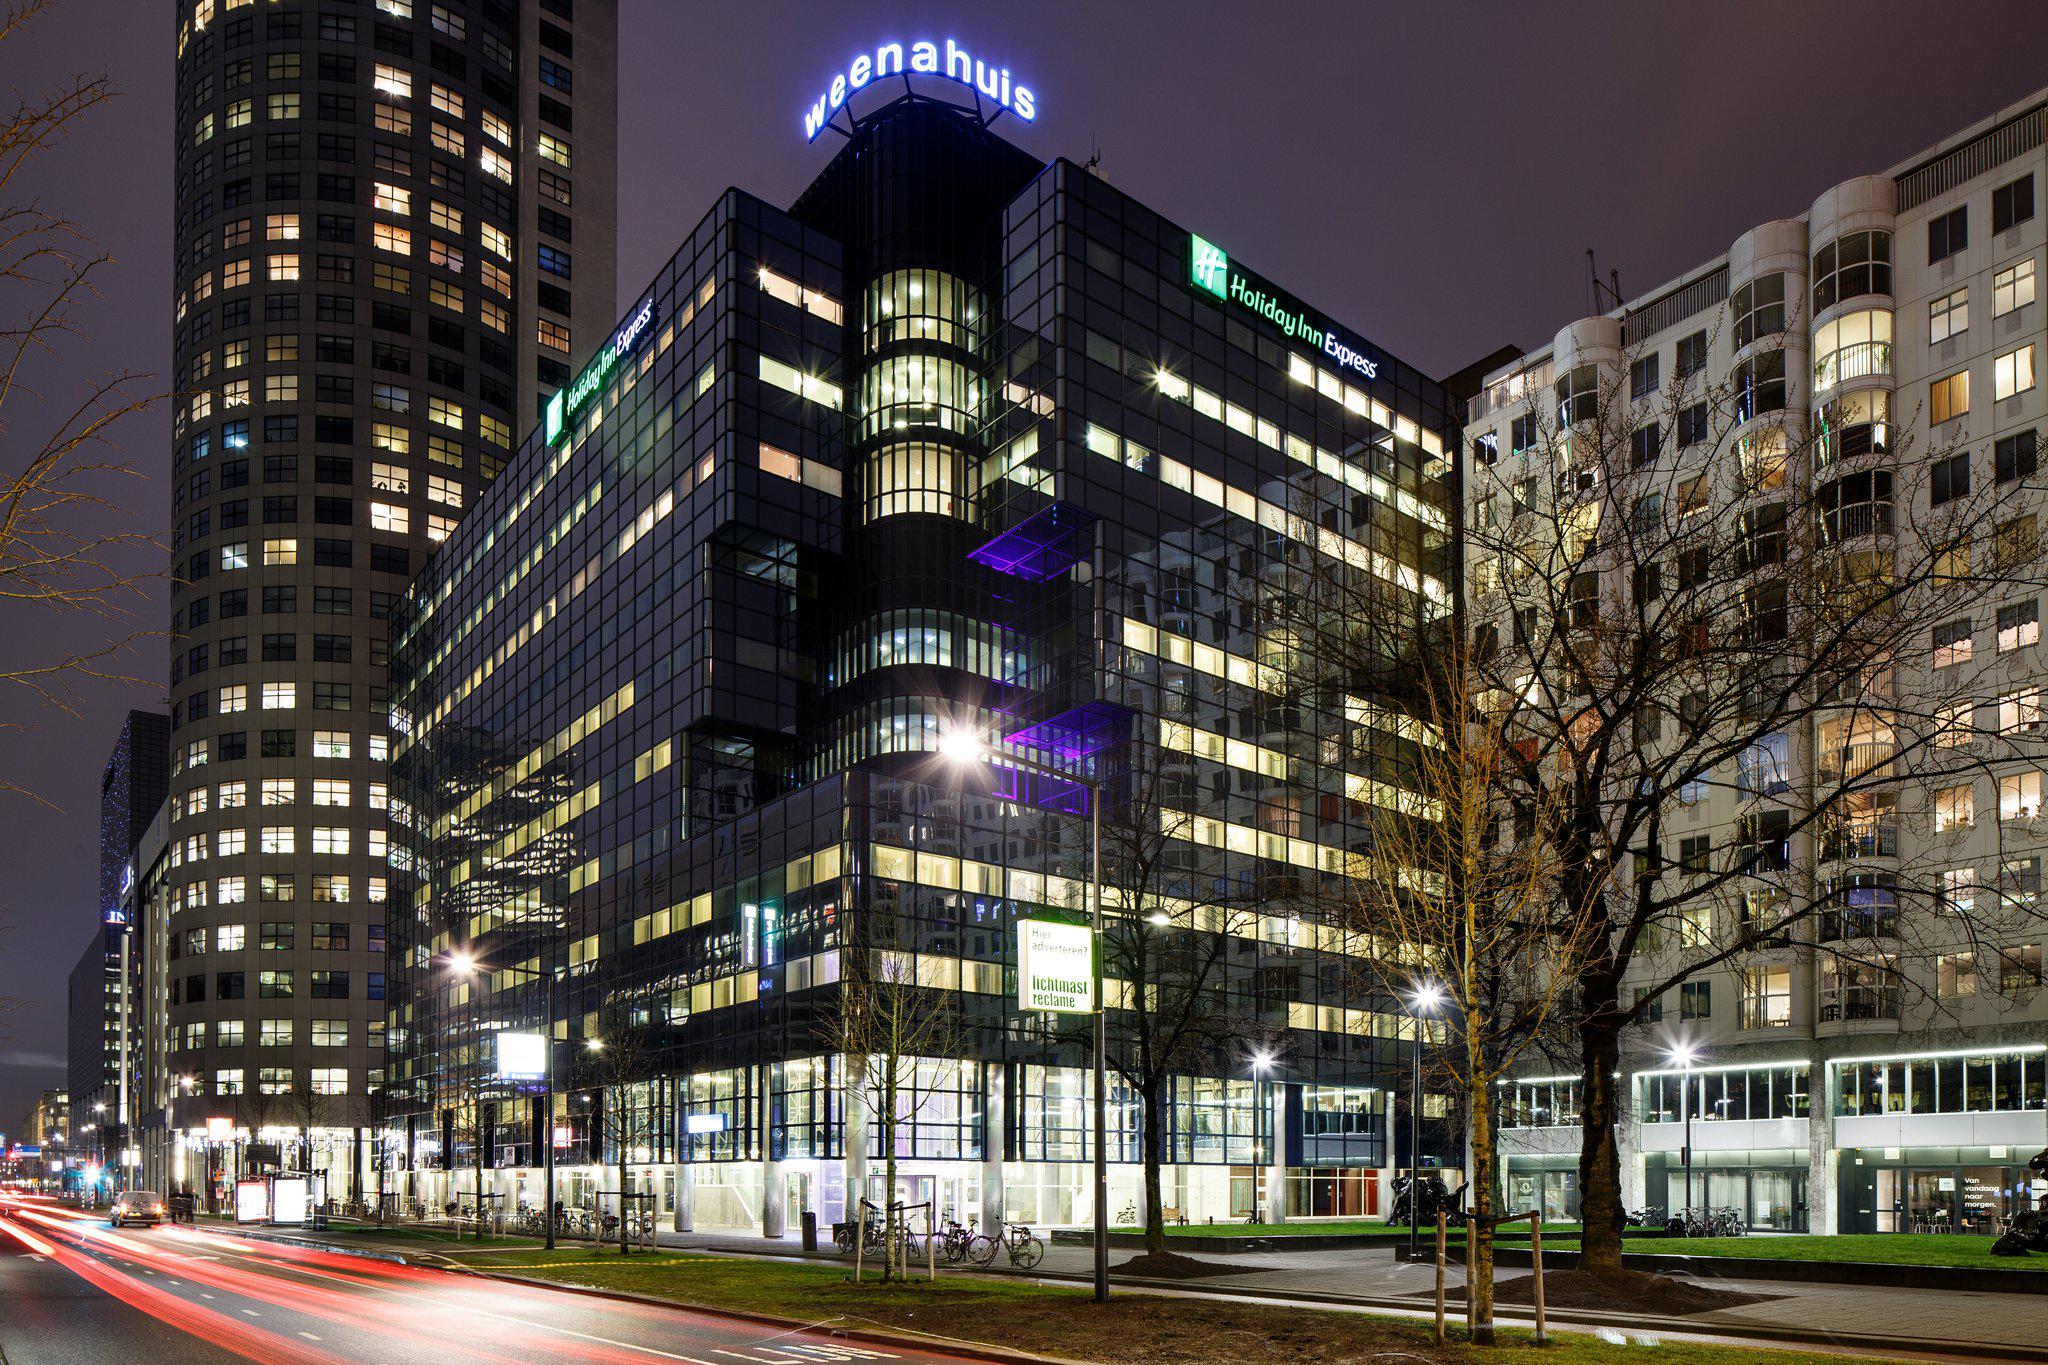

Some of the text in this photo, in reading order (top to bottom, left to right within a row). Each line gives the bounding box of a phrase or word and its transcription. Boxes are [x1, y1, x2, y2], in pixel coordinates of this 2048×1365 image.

[804, 39, 1036, 138] weenahuis
[1230, 274, 1377, 379] Holiday Inn Express
[567, 302, 652, 416] Holiday Inn Express
[1032, 927, 1051, 939] Hier
[1032, 941, 1088, 956] adverteren?
[1032, 975, 1088, 995] lichtmast
[1032, 993, 1075, 1008] reclame
[1964, 1201, 1997, 1209] morgen.
